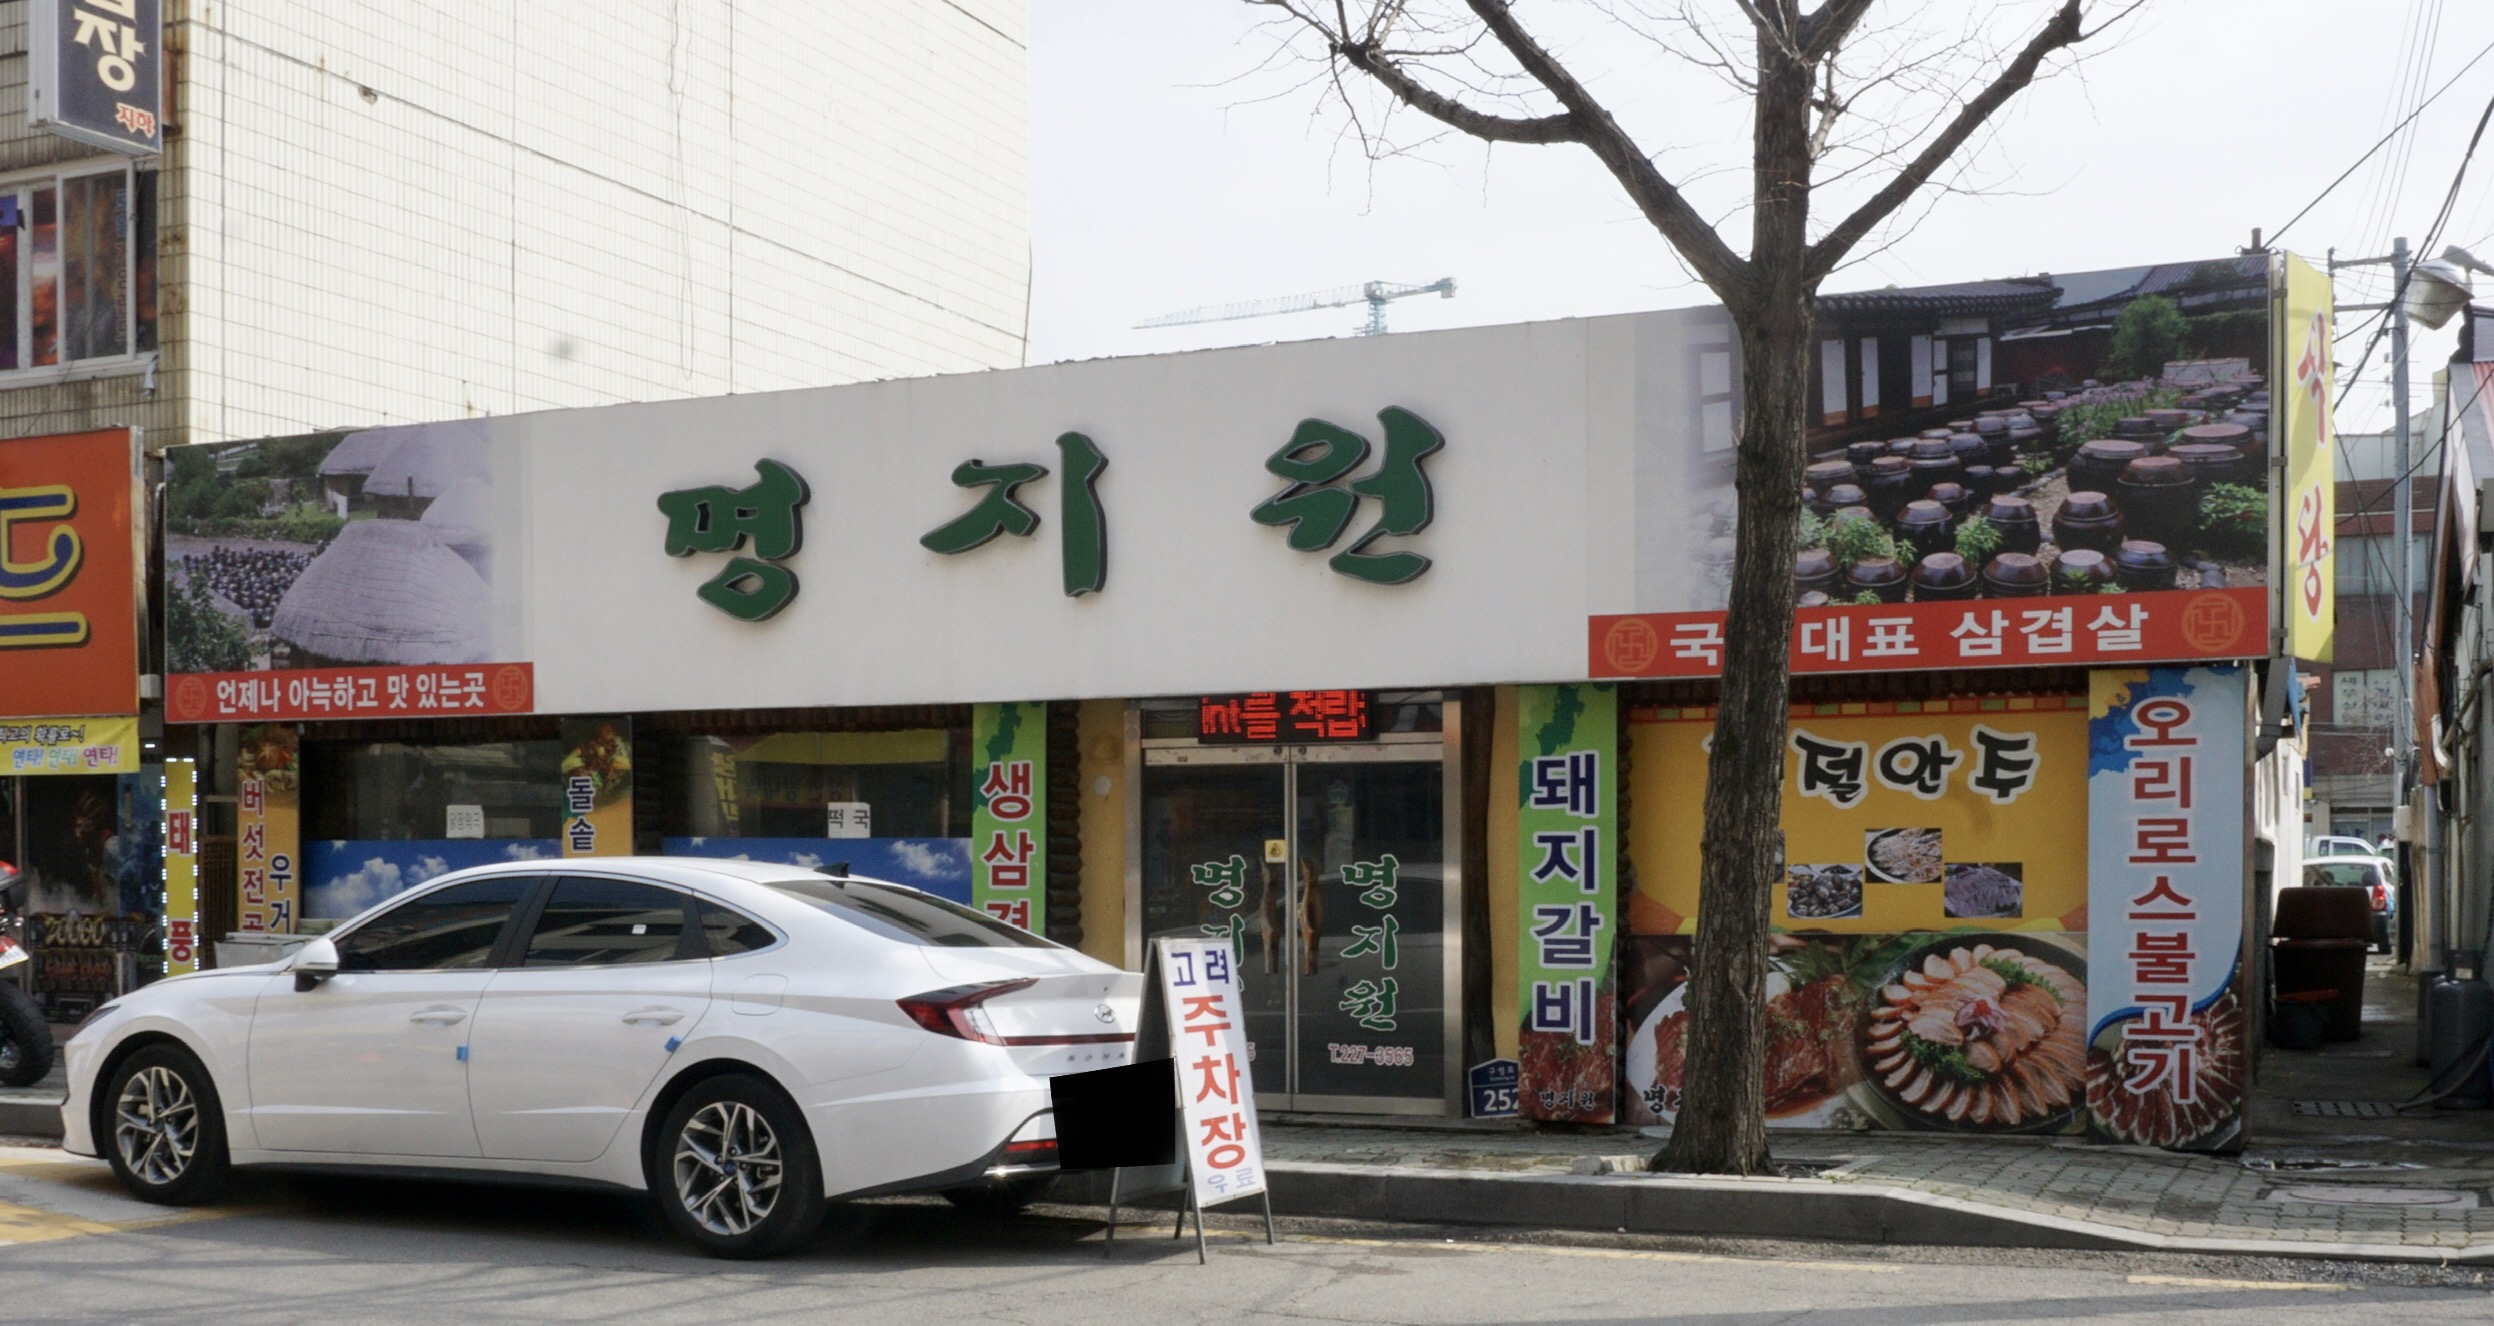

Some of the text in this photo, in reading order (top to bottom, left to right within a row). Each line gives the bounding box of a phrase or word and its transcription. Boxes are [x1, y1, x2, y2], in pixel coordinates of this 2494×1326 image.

[117, 104, 155, 137] 지하
[657, 406, 1446, 621] 명지원
[1801, 615, 1919, 662] 대표
[1950, 603, 2149, 656] 삼겹살
[217, 672, 486, 714] 언제나 아늑하고 맛 있는곳
[568, 776, 594, 852] 돌솥
[168, 812, 192, 962] 태풍
[269, 854, 292, 934] 우거
[1529, 752, 1600, 1044] 돼지갈비
[2127, 700, 2199, 1100] 오리로스불고기
[1171, 949, 1230, 987] 고려
[1339, 854, 1399, 1031] 명지원
[1182, 994, 1247, 1169] 주차장
[1328, 1043, 1414, 1066] T.227-3565
[1541, 1089, 1596, 1110] 명지원
